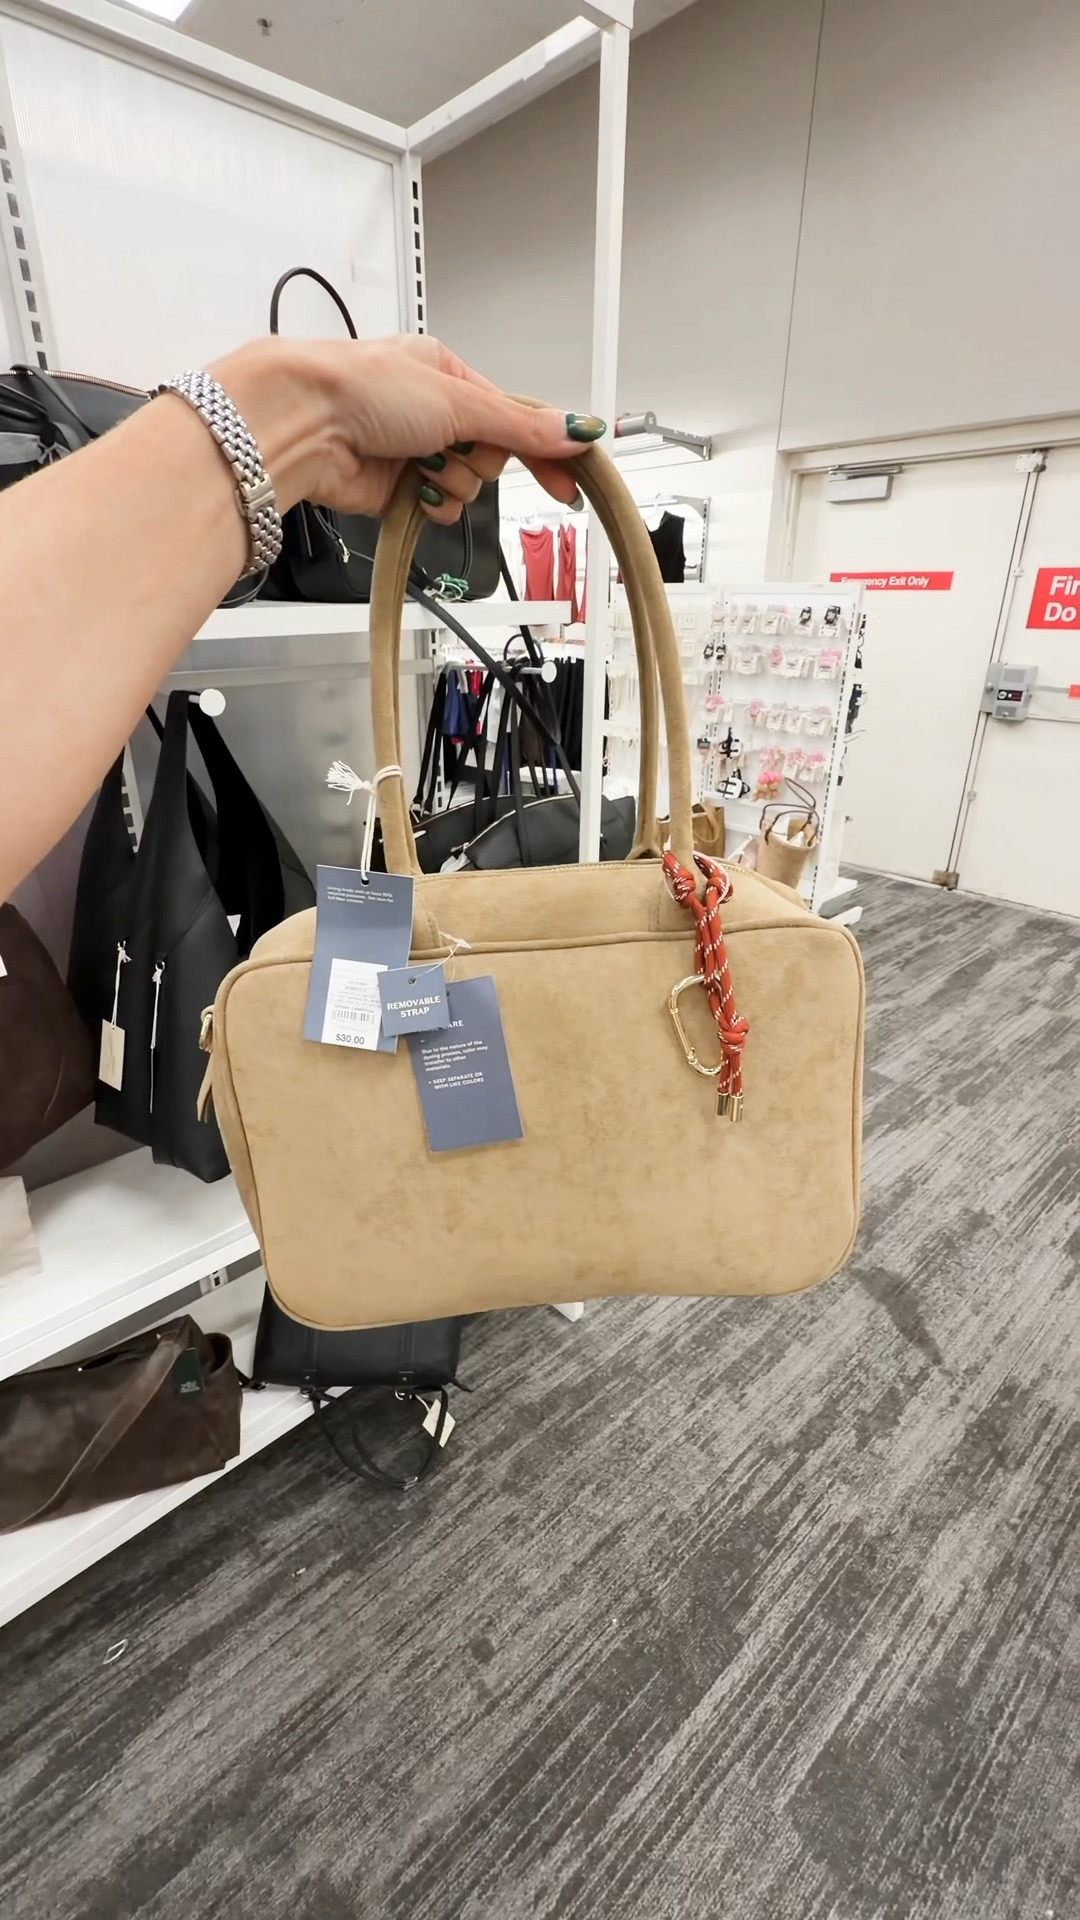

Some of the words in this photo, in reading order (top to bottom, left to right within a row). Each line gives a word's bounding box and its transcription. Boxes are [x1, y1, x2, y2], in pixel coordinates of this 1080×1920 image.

[888, 576, 906, 586] Exit
[907, 575, 930, 588] Only
[1043, 602, 1077, 622] Do
[387, 996, 441, 1010] REMOVABLE
[400, 1007, 430, 1018] STRAP
[445, 1020, 464, 1029] ARE
[335, 1033, 365, 1045] $30.00
[447, 1073, 473, 1082] SEPARATE
[462, 1077, 484, 1085] COLORS
